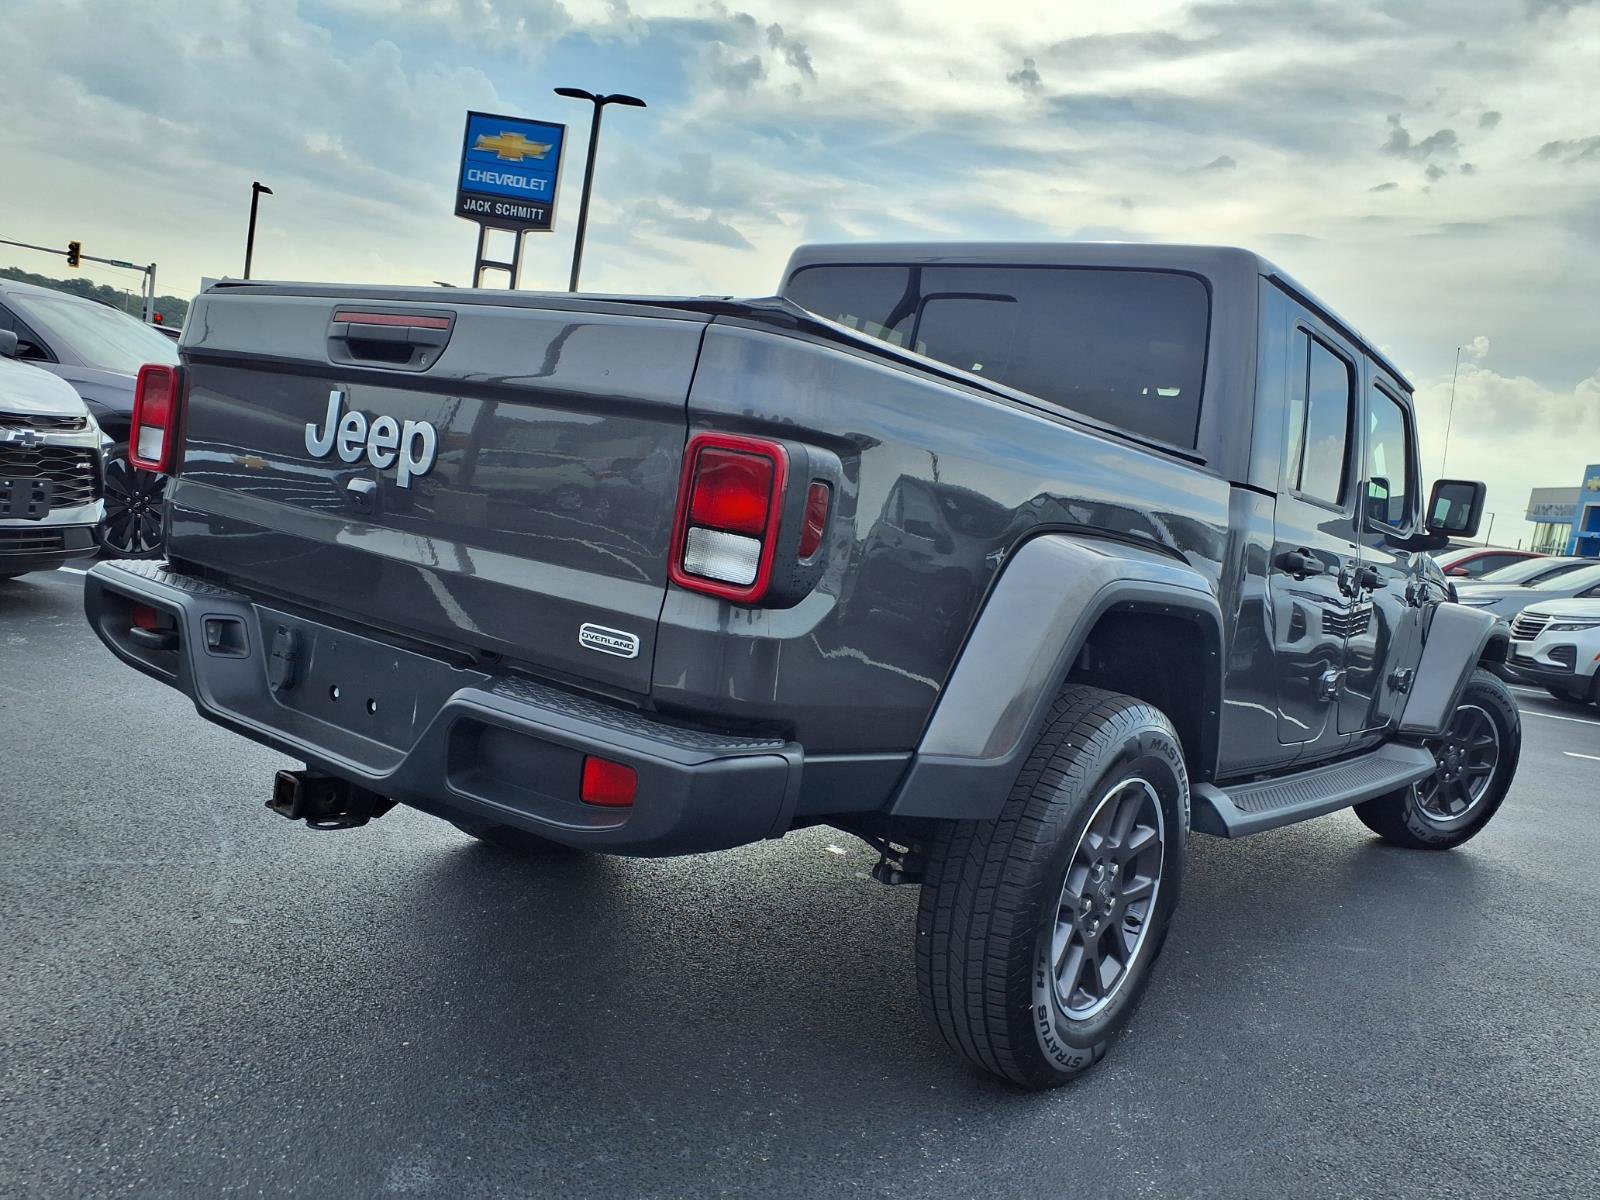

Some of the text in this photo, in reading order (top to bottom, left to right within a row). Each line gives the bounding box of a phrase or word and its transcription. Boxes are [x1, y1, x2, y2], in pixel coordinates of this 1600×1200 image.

[467, 169, 548, 191] CHEVROLET
[463, 198, 545, 220] JACK SCHMITT
[305, 390, 438, 489] Jeep
[581, 632, 635, 650] OVERLAND
[1037, 1004, 1084, 1068] STRATUS
